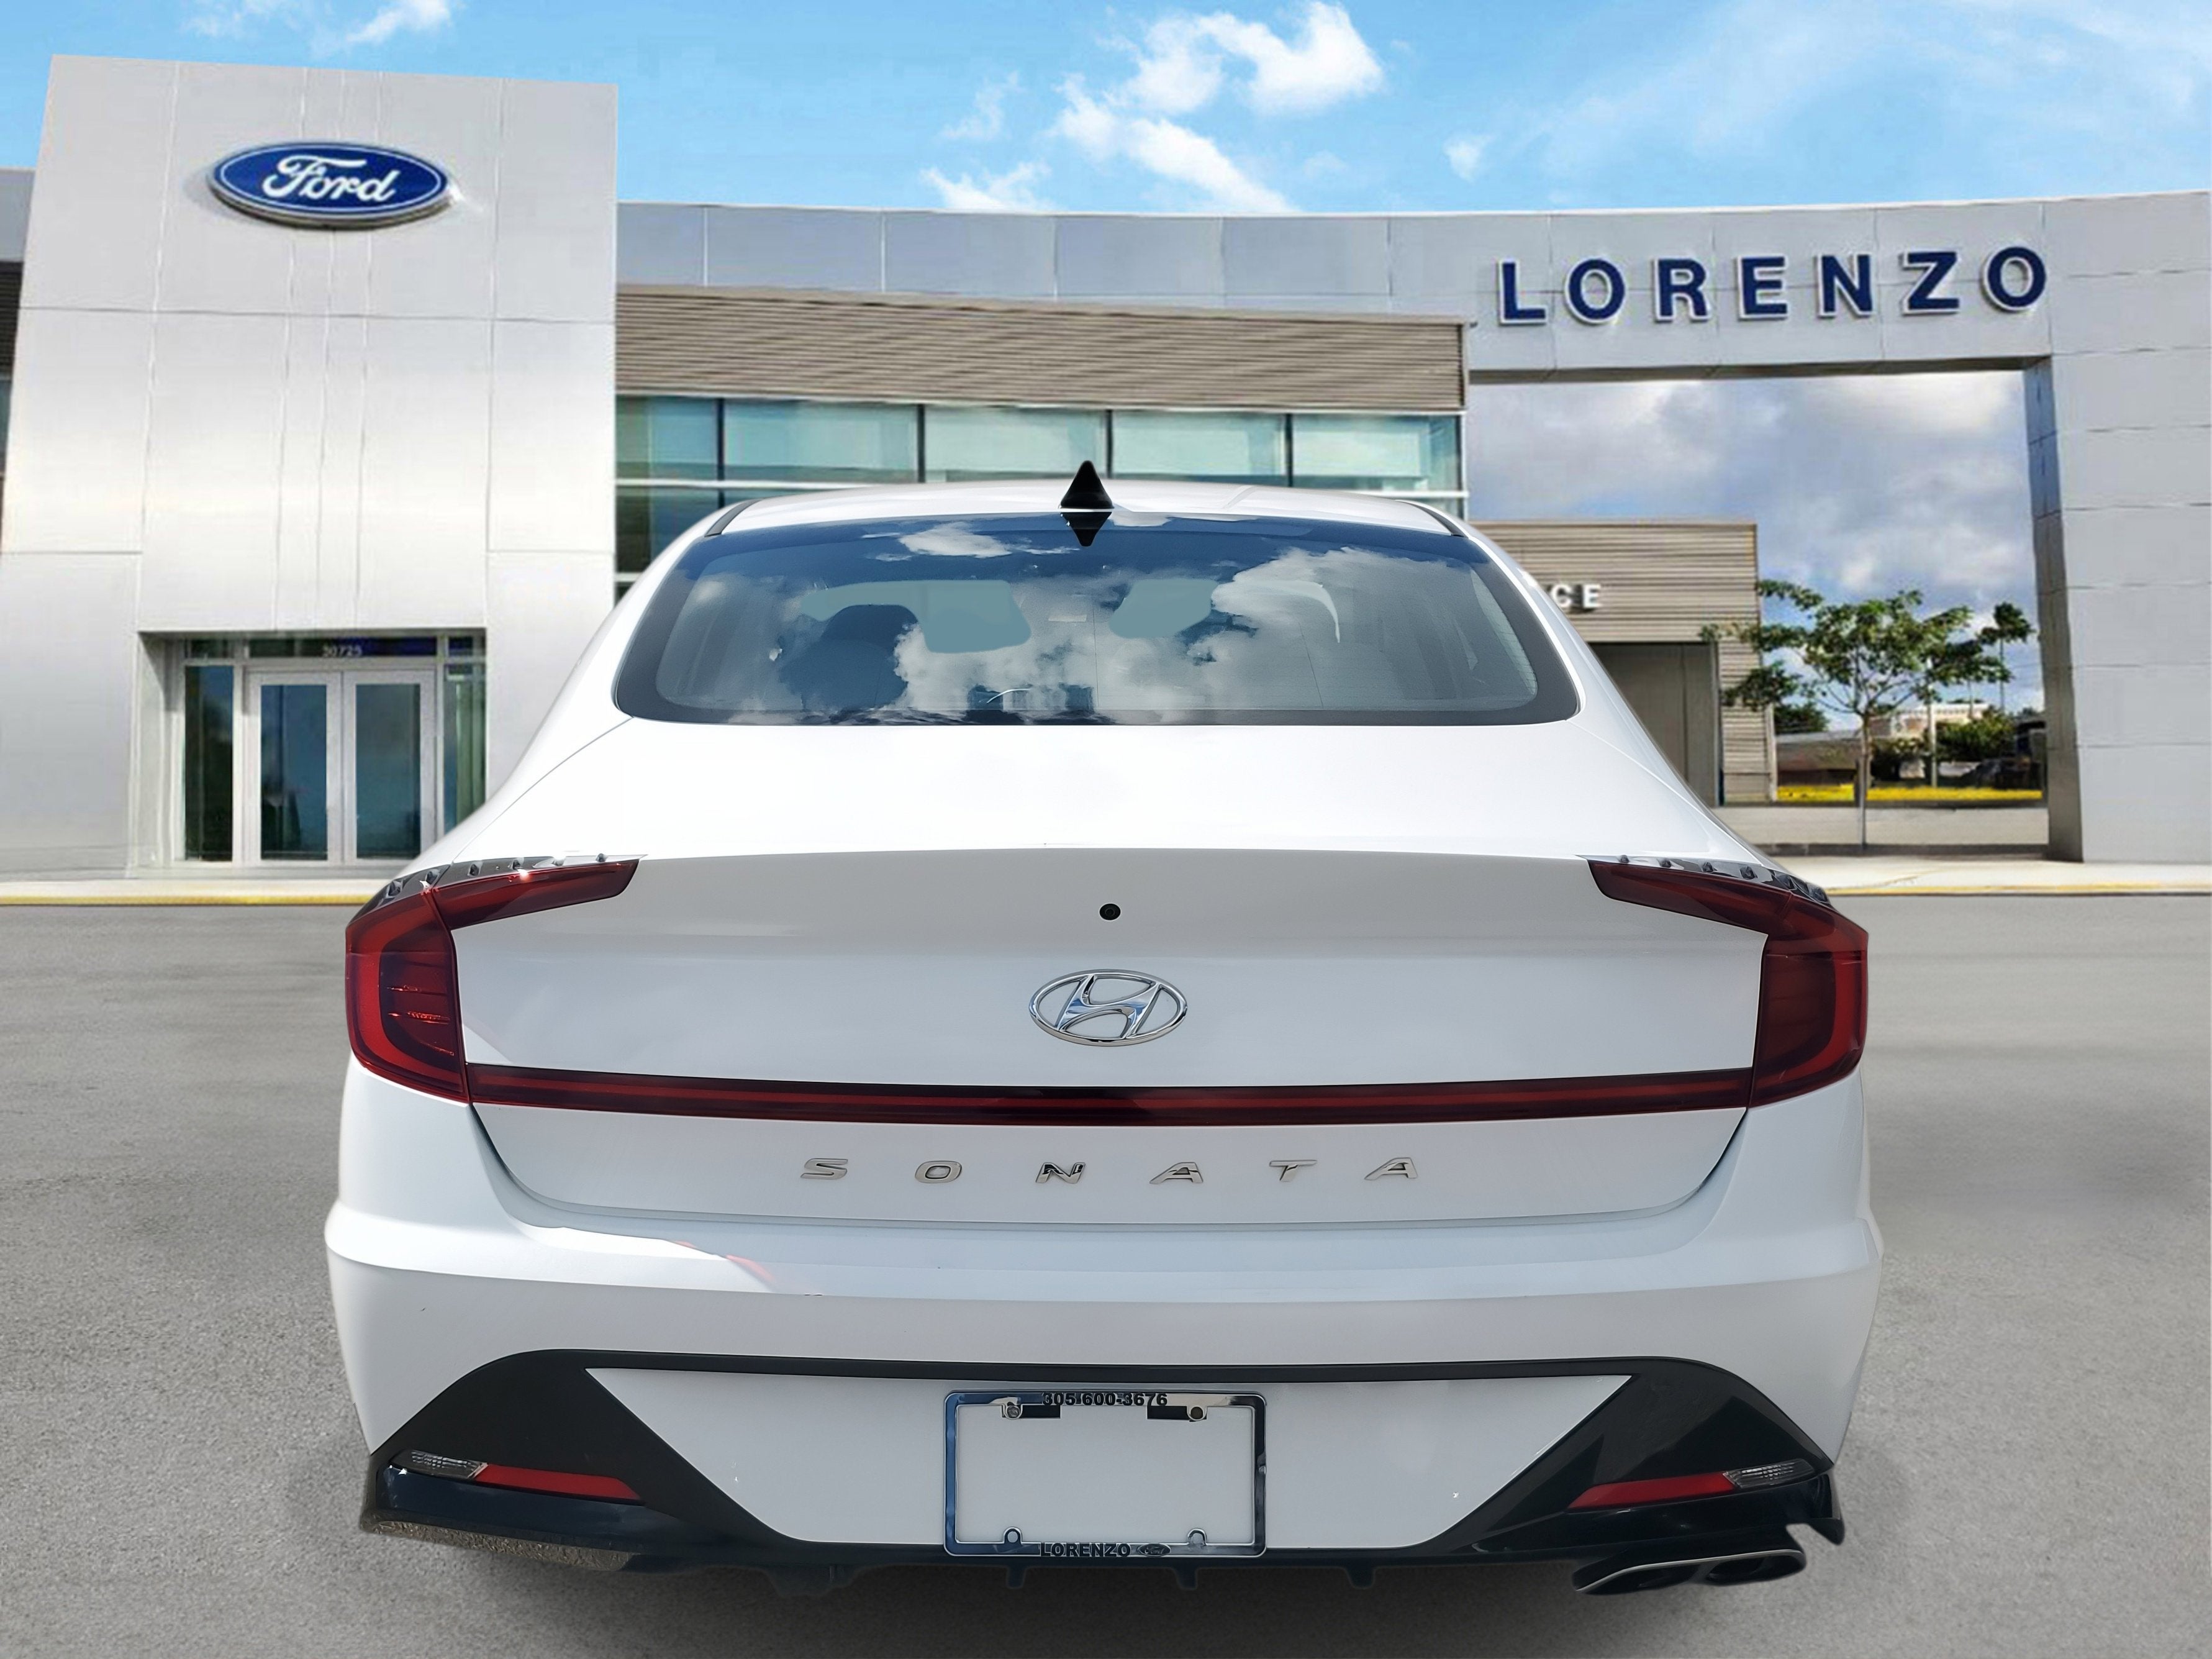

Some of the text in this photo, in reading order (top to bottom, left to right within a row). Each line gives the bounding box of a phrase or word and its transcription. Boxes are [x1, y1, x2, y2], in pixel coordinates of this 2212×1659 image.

[263, 155, 401, 202] Ford
[1498, 247, 2047, 325] LORENZO
[800, 1157, 1418, 1184] SONATA
[1040, 1543, 1131, 1557] LORENZO
